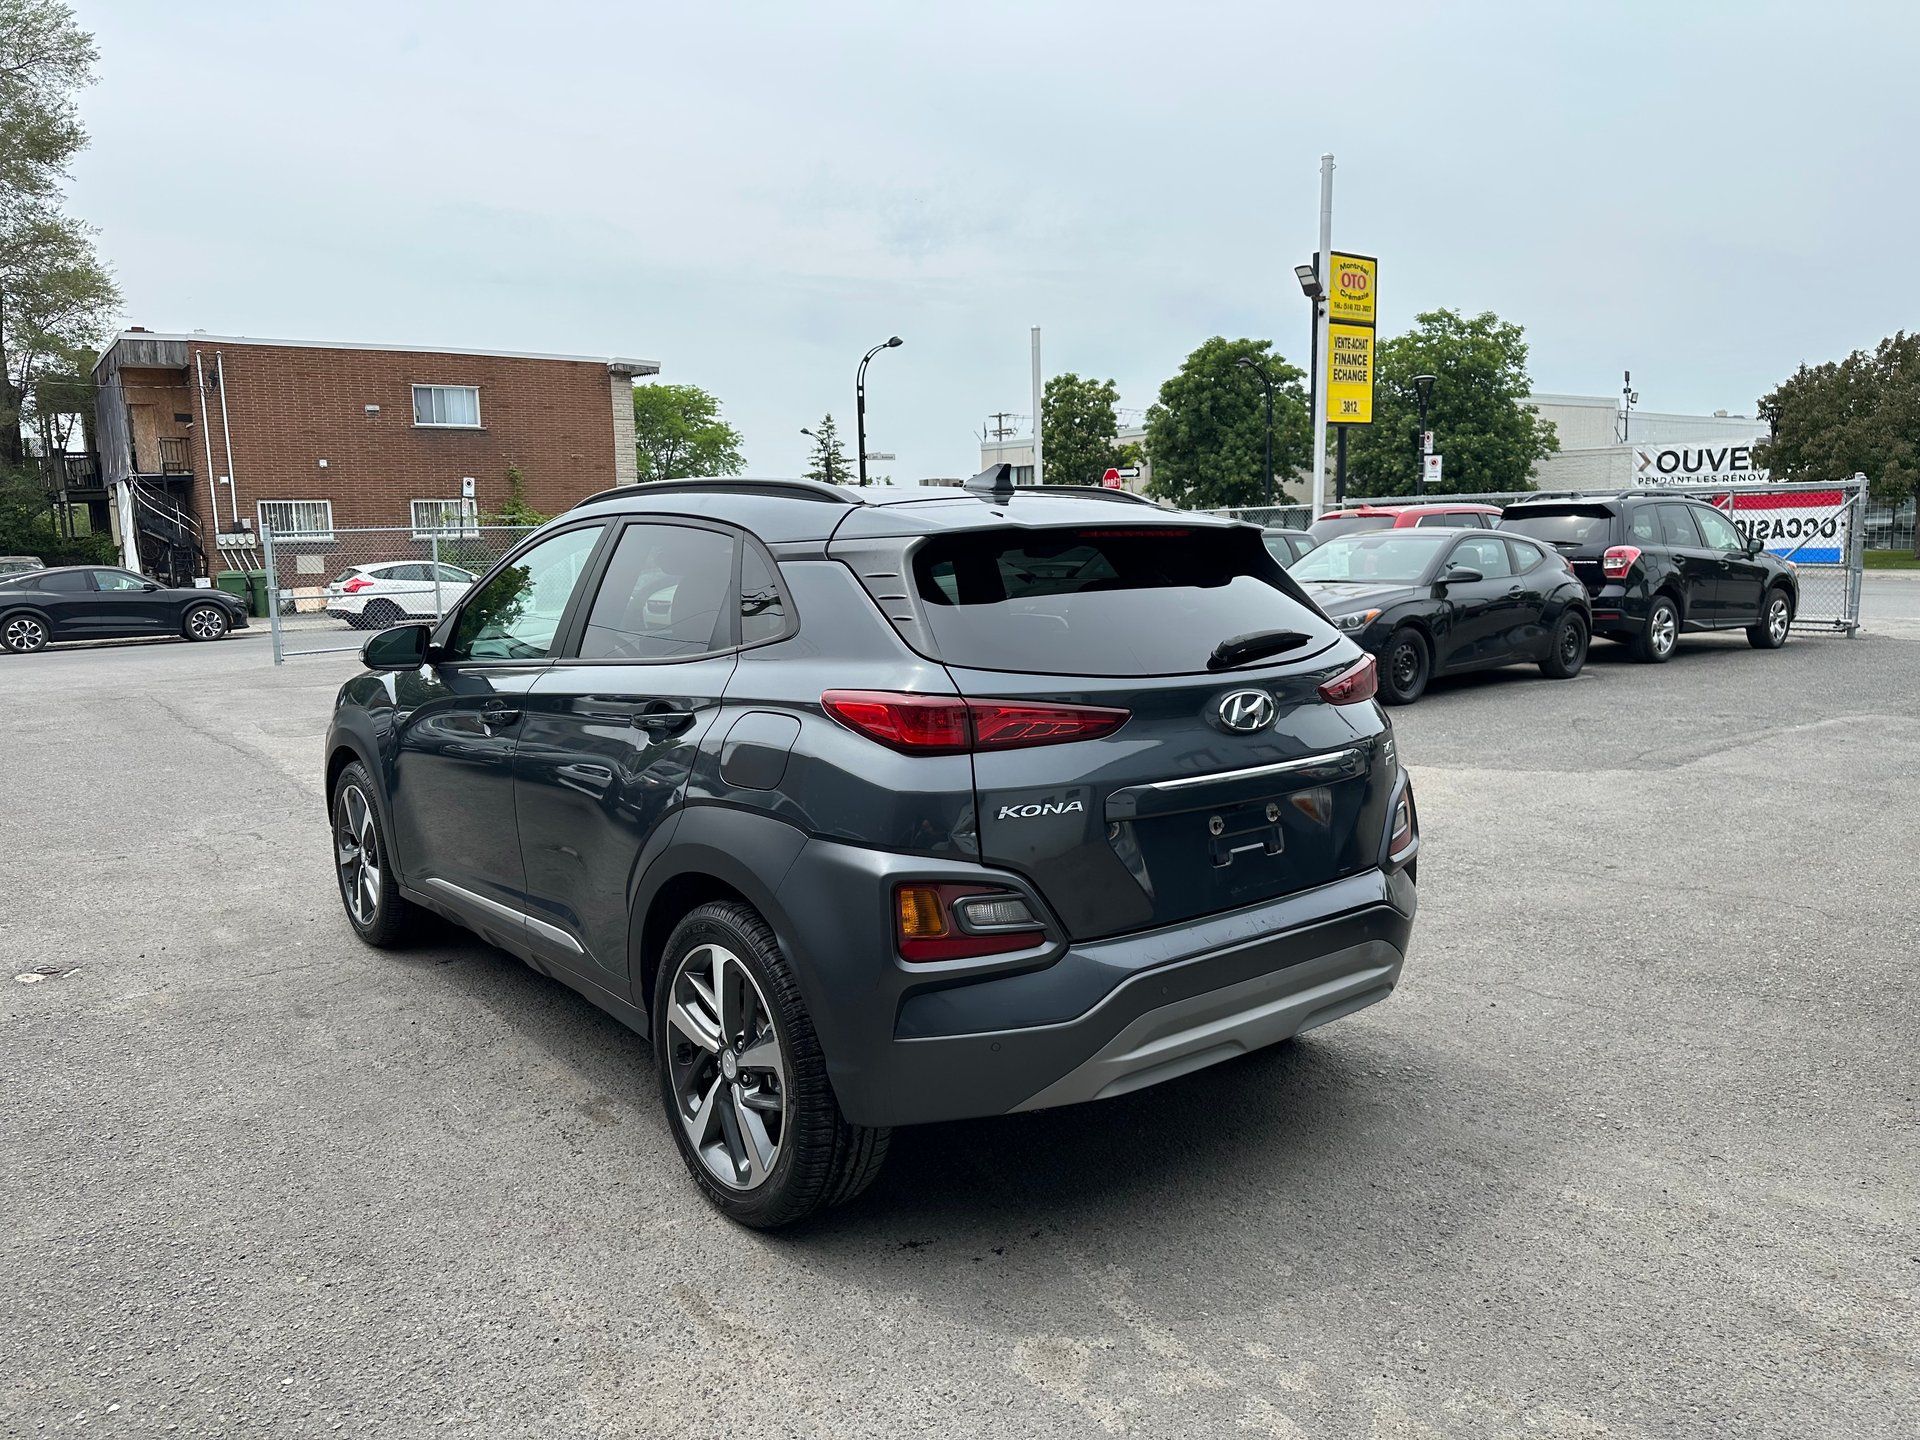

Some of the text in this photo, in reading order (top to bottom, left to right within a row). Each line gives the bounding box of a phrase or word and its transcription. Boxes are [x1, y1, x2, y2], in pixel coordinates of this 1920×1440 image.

[1340, 263, 1369, 275] Montréal
[1342, 273, 1366, 290] OTO
[1340, 289, 1369, 301] Crémazie
[1334, 337, 1368, 350] VENTE-ACHAT
[1334, 353, 1367, 366] FINANCE
[1334, 369, 1367, 382] ECHANGE
[1343, 401, 1357, 413] 3812
[1656, 446, 1755, 474] OUVE
[1638, 477, 1692, 485] PENDANT
[1696, 475, 1717, 483] LES
[998, 801, 1084, 819] KONA
